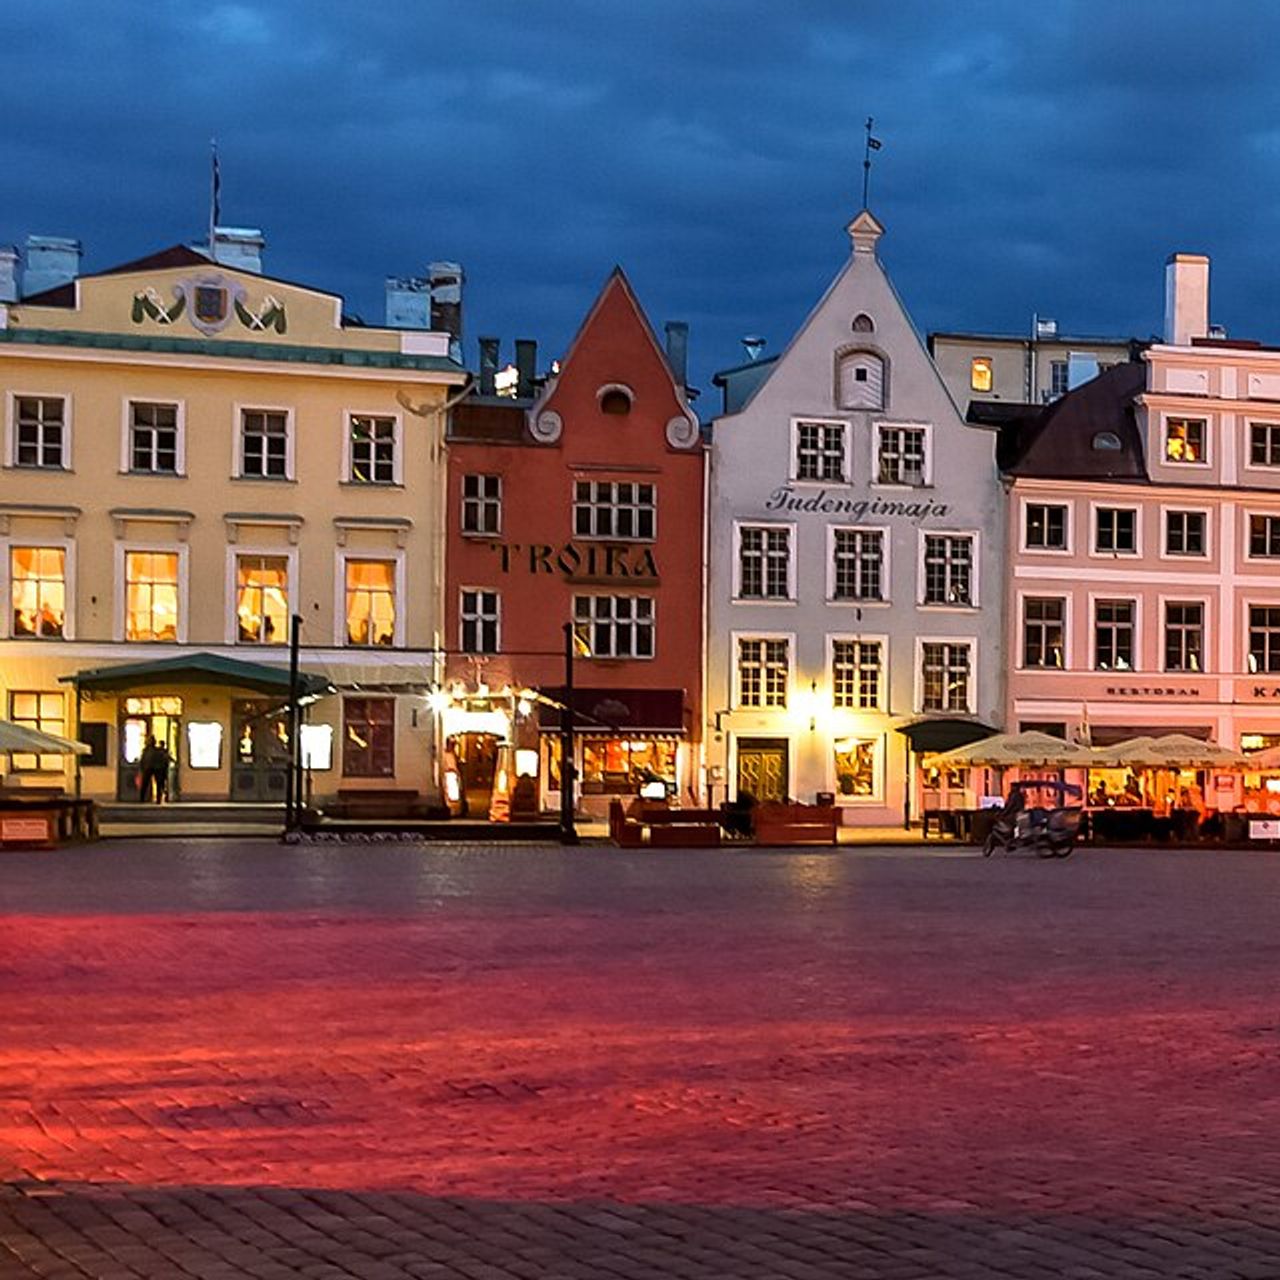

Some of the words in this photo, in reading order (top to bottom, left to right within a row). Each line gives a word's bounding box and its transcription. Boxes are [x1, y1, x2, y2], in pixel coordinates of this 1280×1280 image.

[766, 485, 949, 523] Tudengimaja
[490, 543, 658, 577] TROIKA
[1106, 686, 1200, 697] RESTORAN
